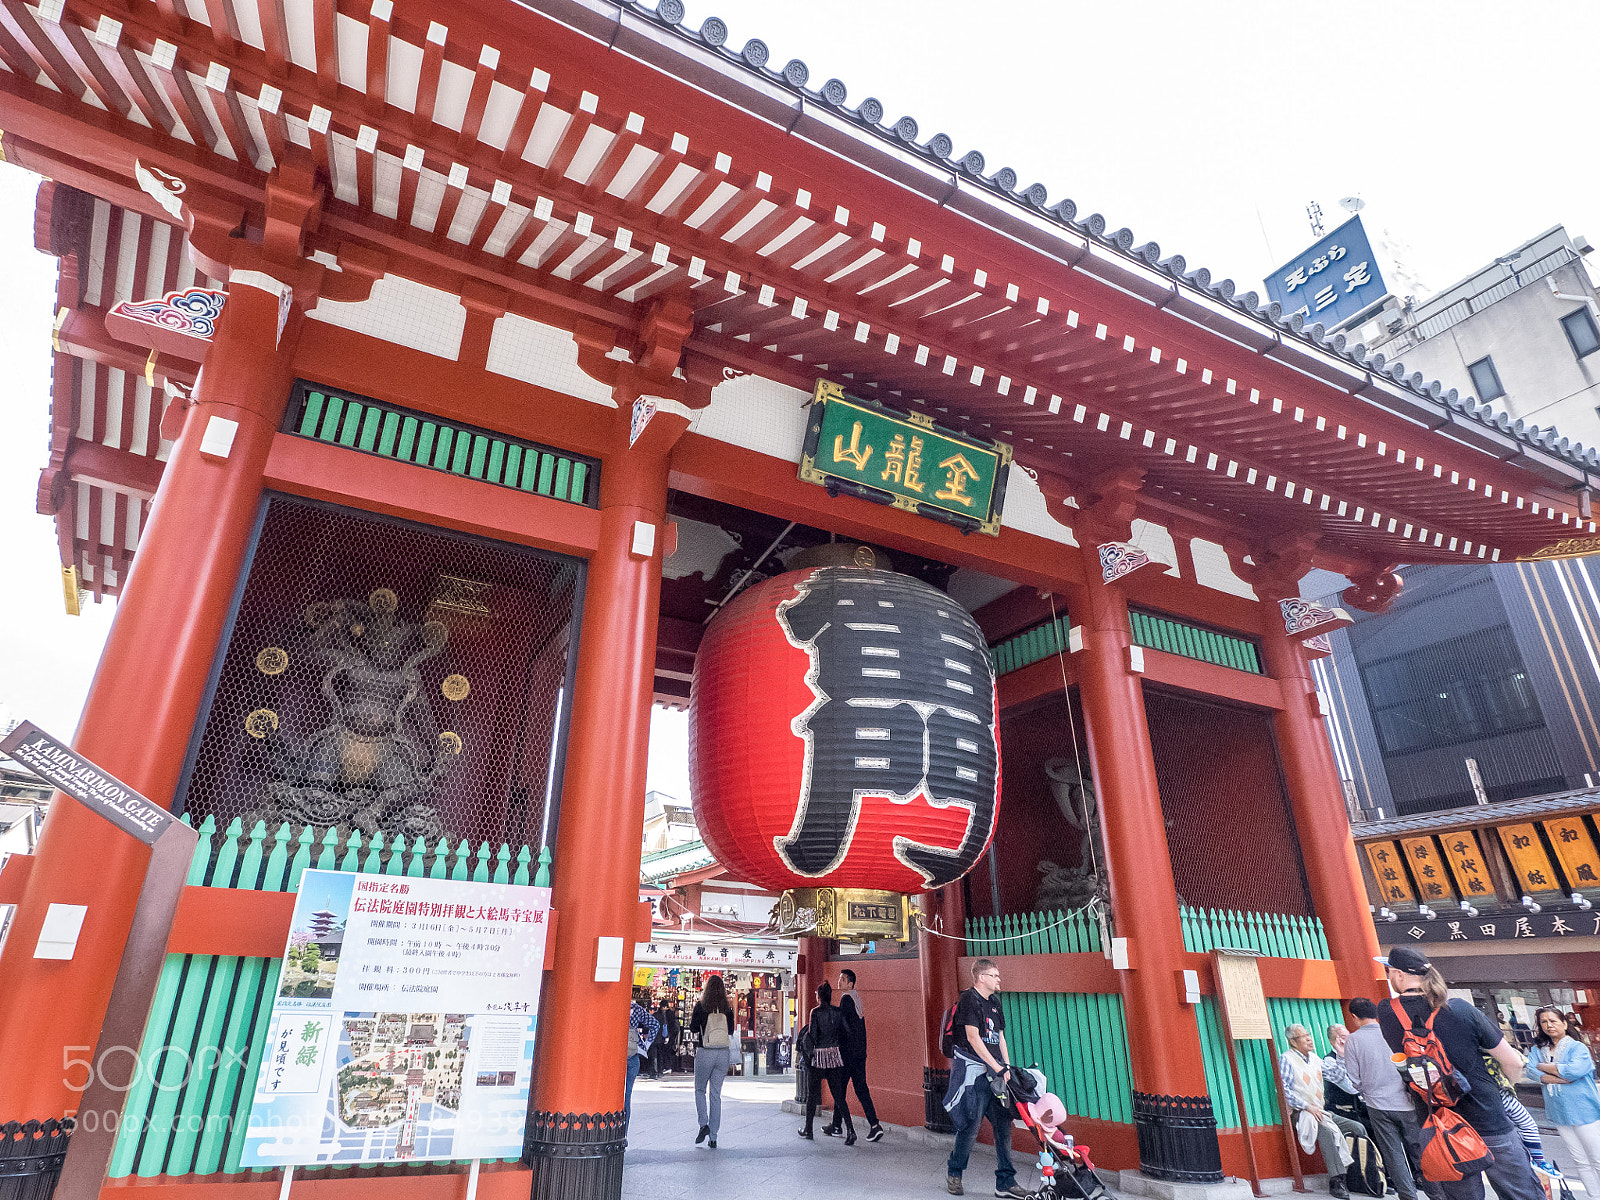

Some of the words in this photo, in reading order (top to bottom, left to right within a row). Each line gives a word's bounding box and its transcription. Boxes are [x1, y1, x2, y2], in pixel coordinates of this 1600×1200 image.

[1284, 244, 1347, 293] 天ぷら
[30, 738, 130, 803] KAMINARIMON
[125, 800, 164, 827] GATE
[357, 881, 410, 895] 国指定名勝
[1453, 840, 1487, 893] 千代紙
[271, 1028, 293, 1091] が見頃です
[295, 1020, 324, 1067] 新緑
